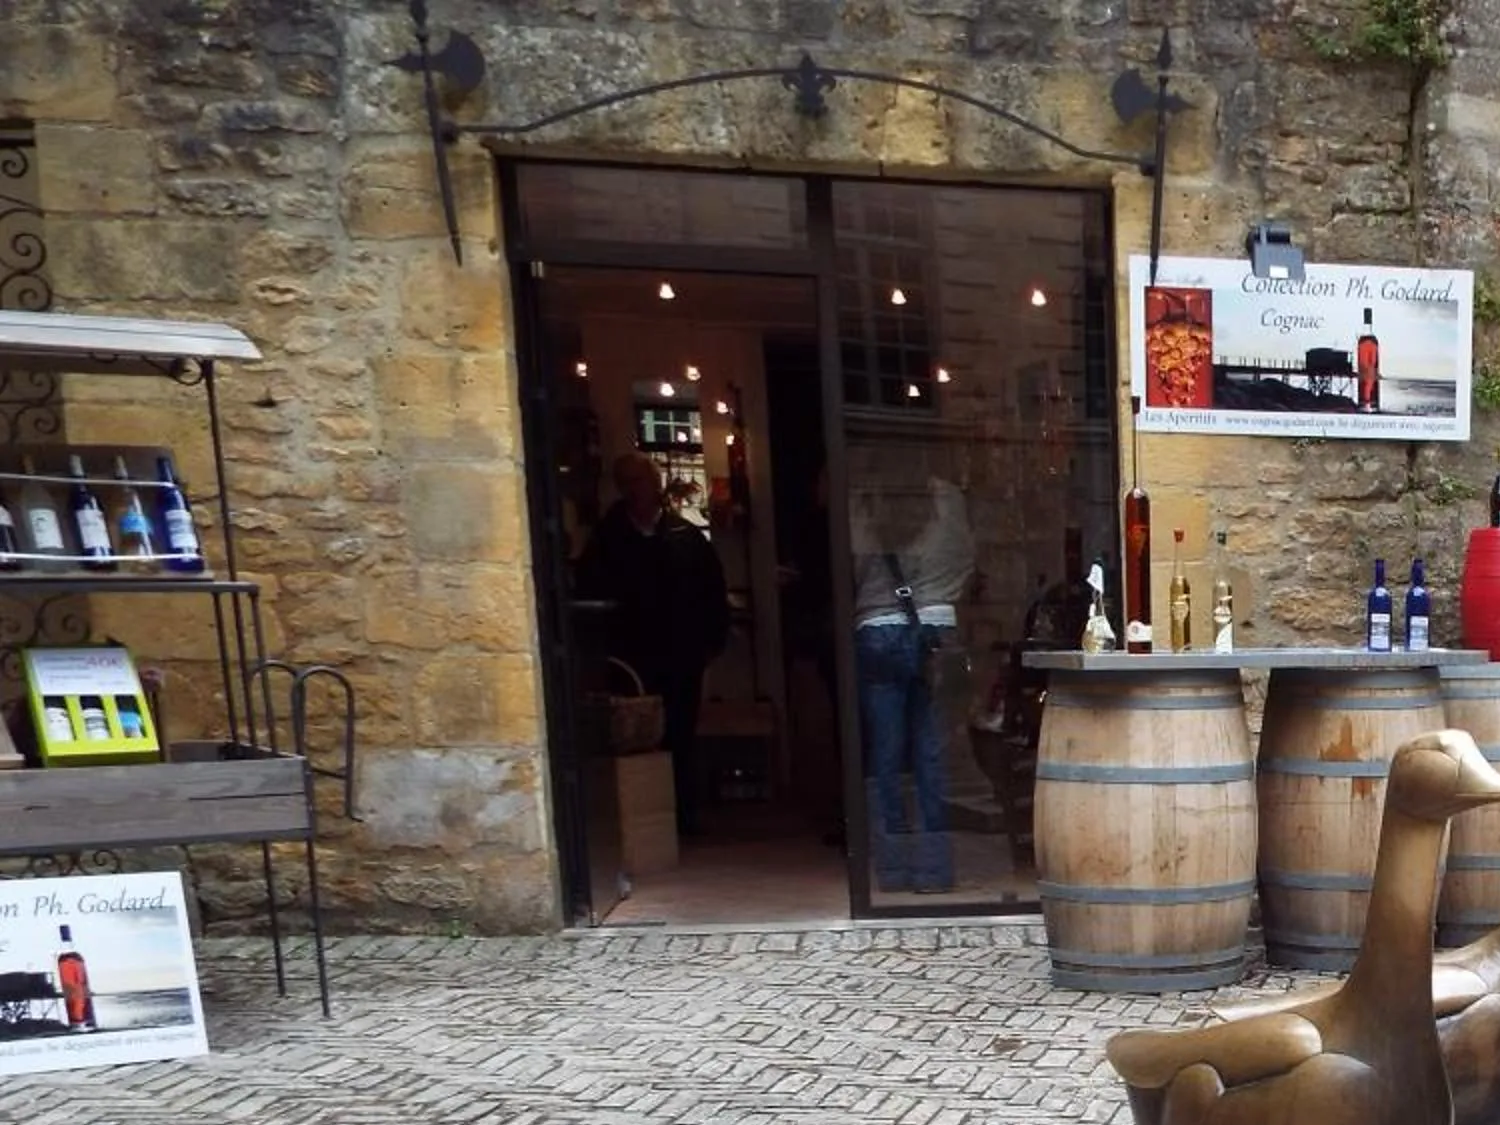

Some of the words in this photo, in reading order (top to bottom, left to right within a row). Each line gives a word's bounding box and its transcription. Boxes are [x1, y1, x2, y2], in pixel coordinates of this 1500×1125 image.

[1345, 275, 1373, 298] Ph.
[1381, 278, 1455, 303] Godard
[1260, 307, 1325, 334] Cognac
[34, 892, 70, 917] Ph.
[77, 885, 166, 915] Godard
